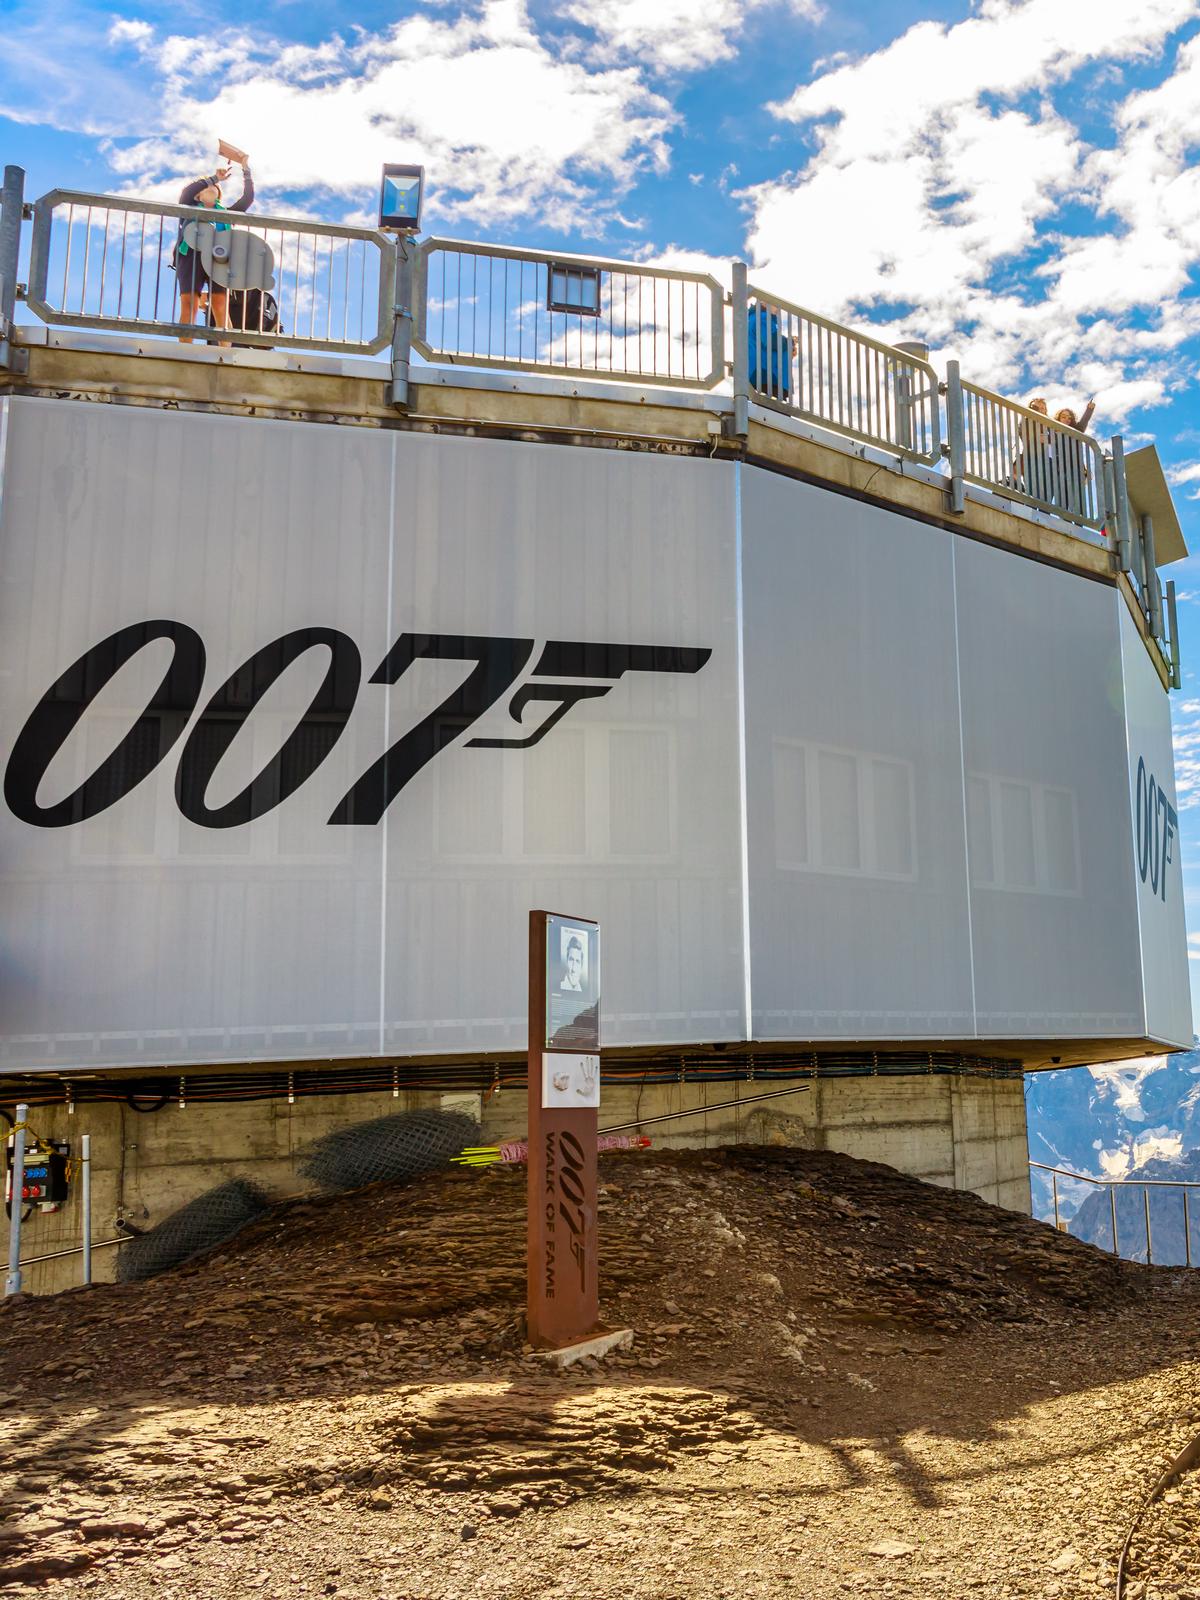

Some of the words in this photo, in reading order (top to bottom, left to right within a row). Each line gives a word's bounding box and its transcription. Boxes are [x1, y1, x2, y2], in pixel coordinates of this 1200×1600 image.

[4, 619, 535, 829] 007
[1136, 755, 1168, 903] 007
[545, 1131, 556, 1194] WALK
[559, 1131, 586, 1248] 007
[545, 1202, 556, 1233] OF
[545, 1240, 556, 1299] FAME
